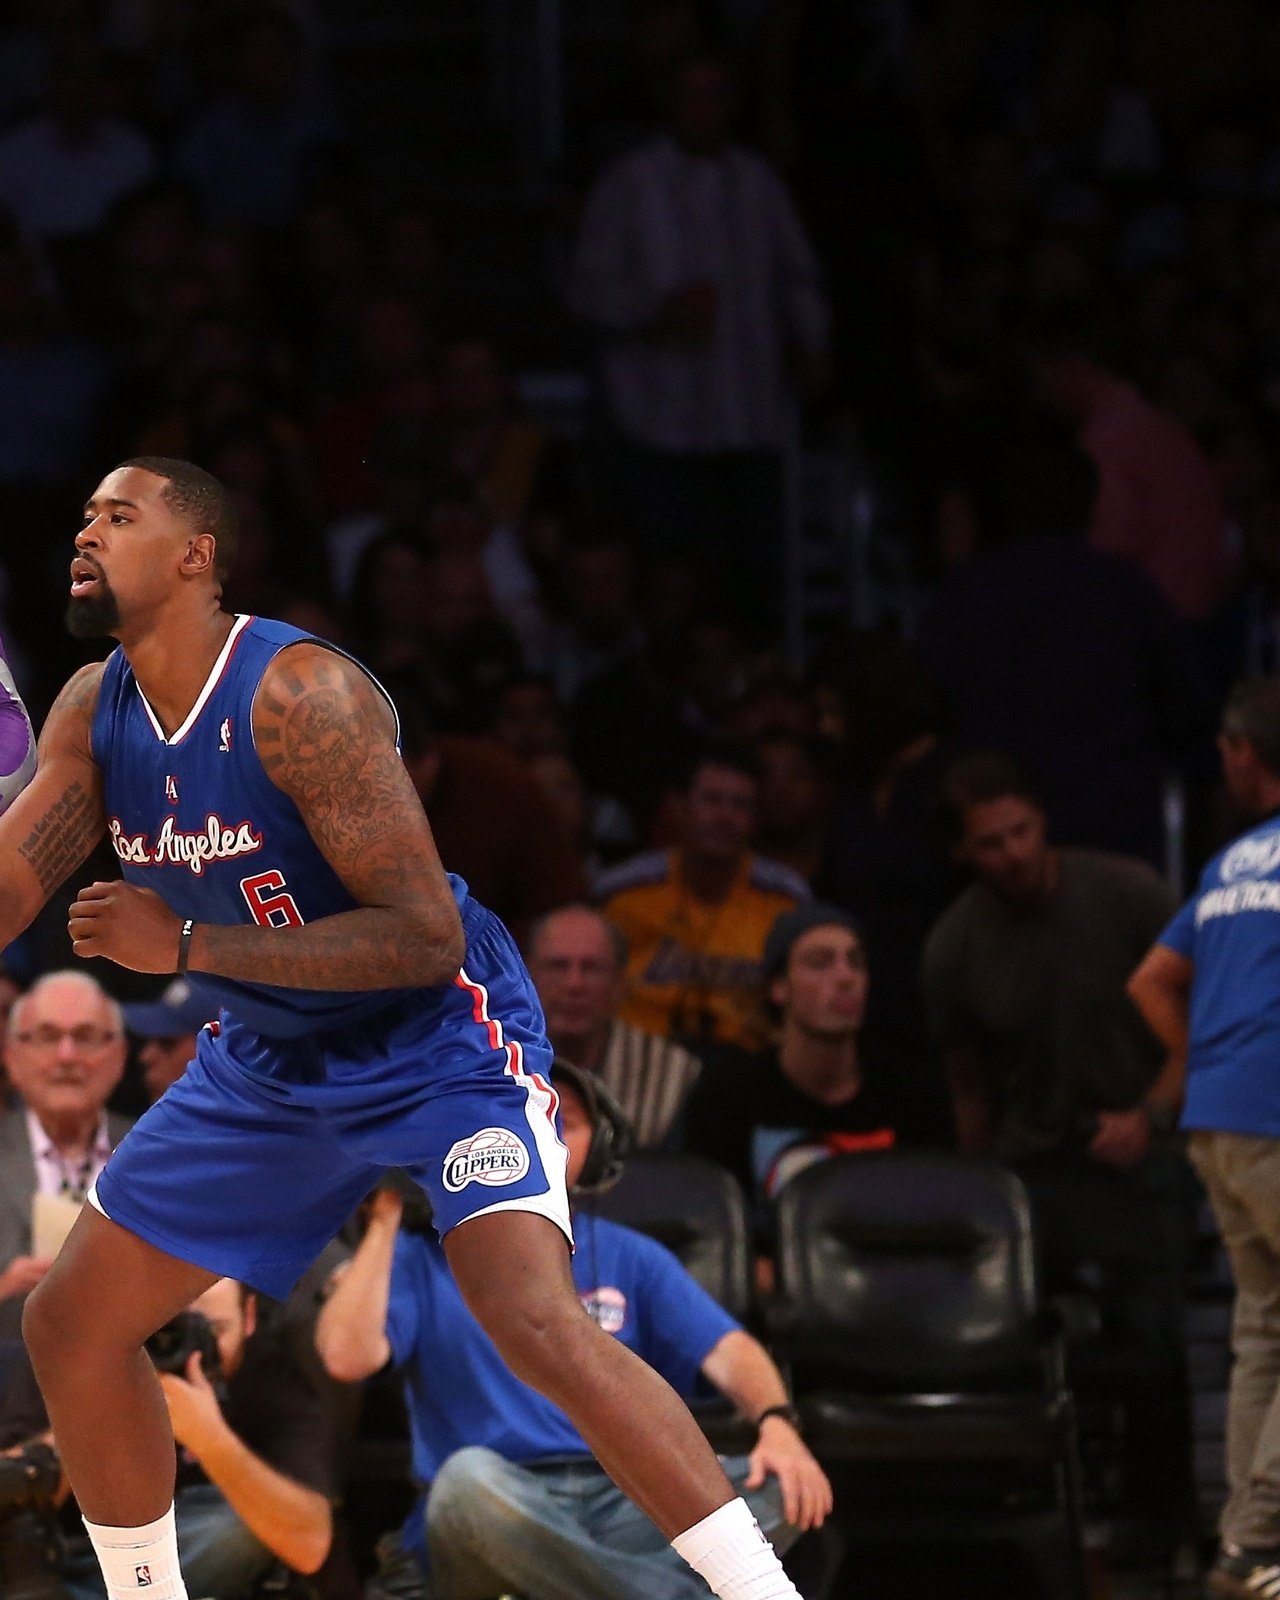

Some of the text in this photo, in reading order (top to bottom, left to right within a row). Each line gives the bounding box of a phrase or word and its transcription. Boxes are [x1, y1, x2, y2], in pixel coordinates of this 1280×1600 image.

[109, 818, 151, 864] Los
[153, 814, 261, 876] Angeles
[240, 869, 305, 928] 6
[446, 1154, 520, 1187] CLIPPERS
[471, 1148, 519, 1159] LOS ANGELES
